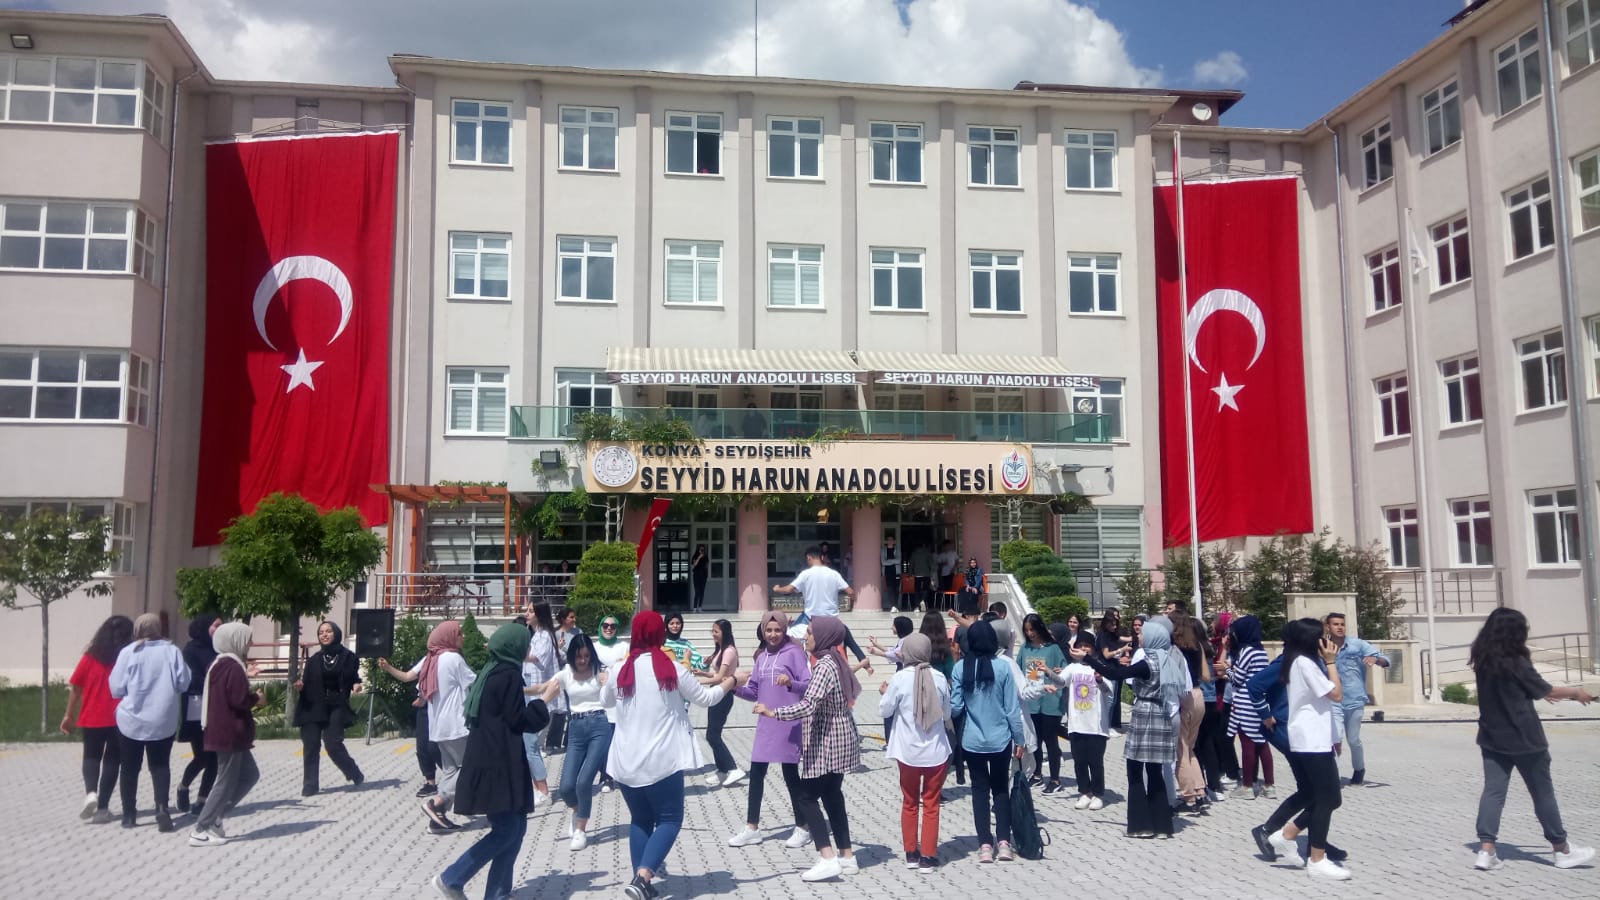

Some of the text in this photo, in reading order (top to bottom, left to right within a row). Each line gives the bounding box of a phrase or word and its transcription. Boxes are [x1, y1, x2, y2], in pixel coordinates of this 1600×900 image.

[680, 373, 732, 384] HARUN
[737, 373, 807, 384] ANADOLU
[936, 374, 983, 385] HARUN
[986, 375, 1049, 386] ANADOLU
[641, 445, 700, 458] KONYA
[714, 443, 811, 461] SEYDİŞEHİR
[641, 462, 994, 491] SEYYİD HARUN ANADOLU LİSESİ
